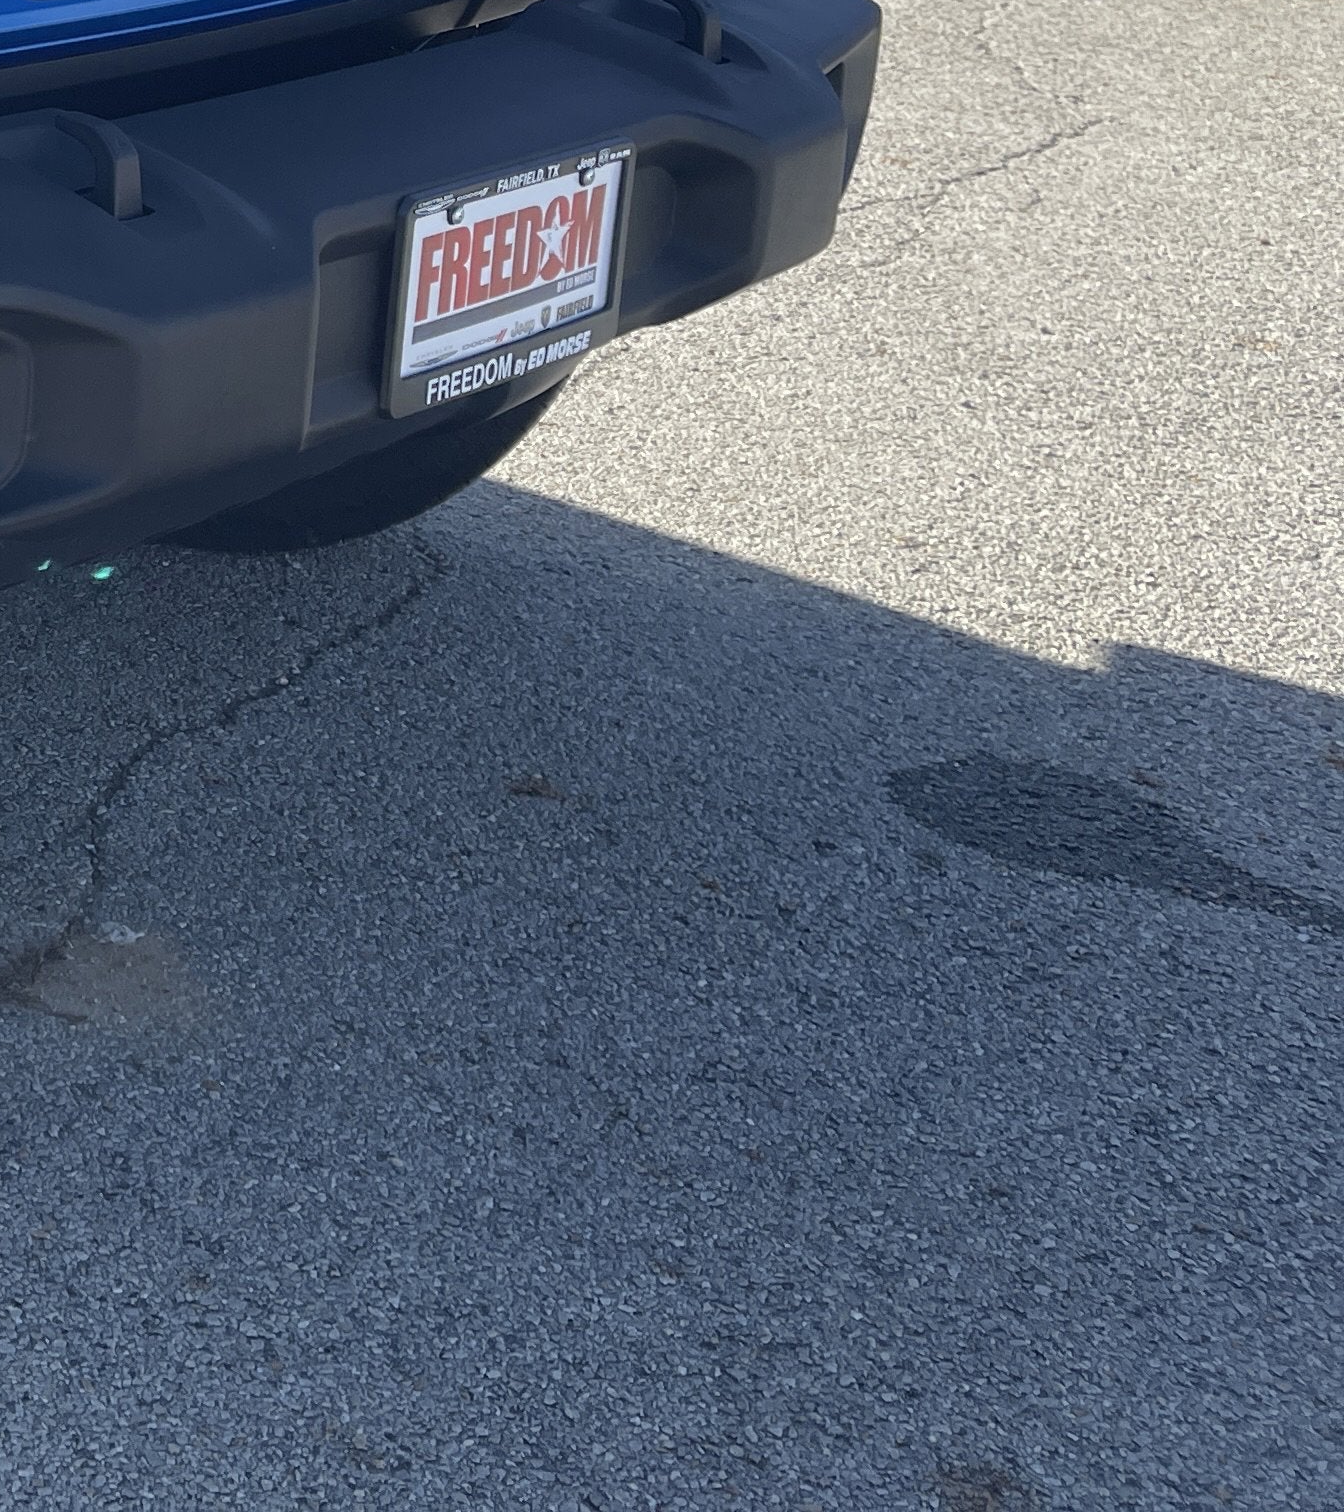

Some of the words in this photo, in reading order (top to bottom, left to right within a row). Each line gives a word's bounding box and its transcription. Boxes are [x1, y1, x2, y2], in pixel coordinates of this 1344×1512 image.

[547, 163, 560, 178] TX
[414, 184, 607, 322] FREEDOM
[511, 318, 535, 337] Jeep
[426, 353, 512, 406] FREEDOM
[527, 347, 547, 371] ED
[545, 330, 590, 362] MORSE
